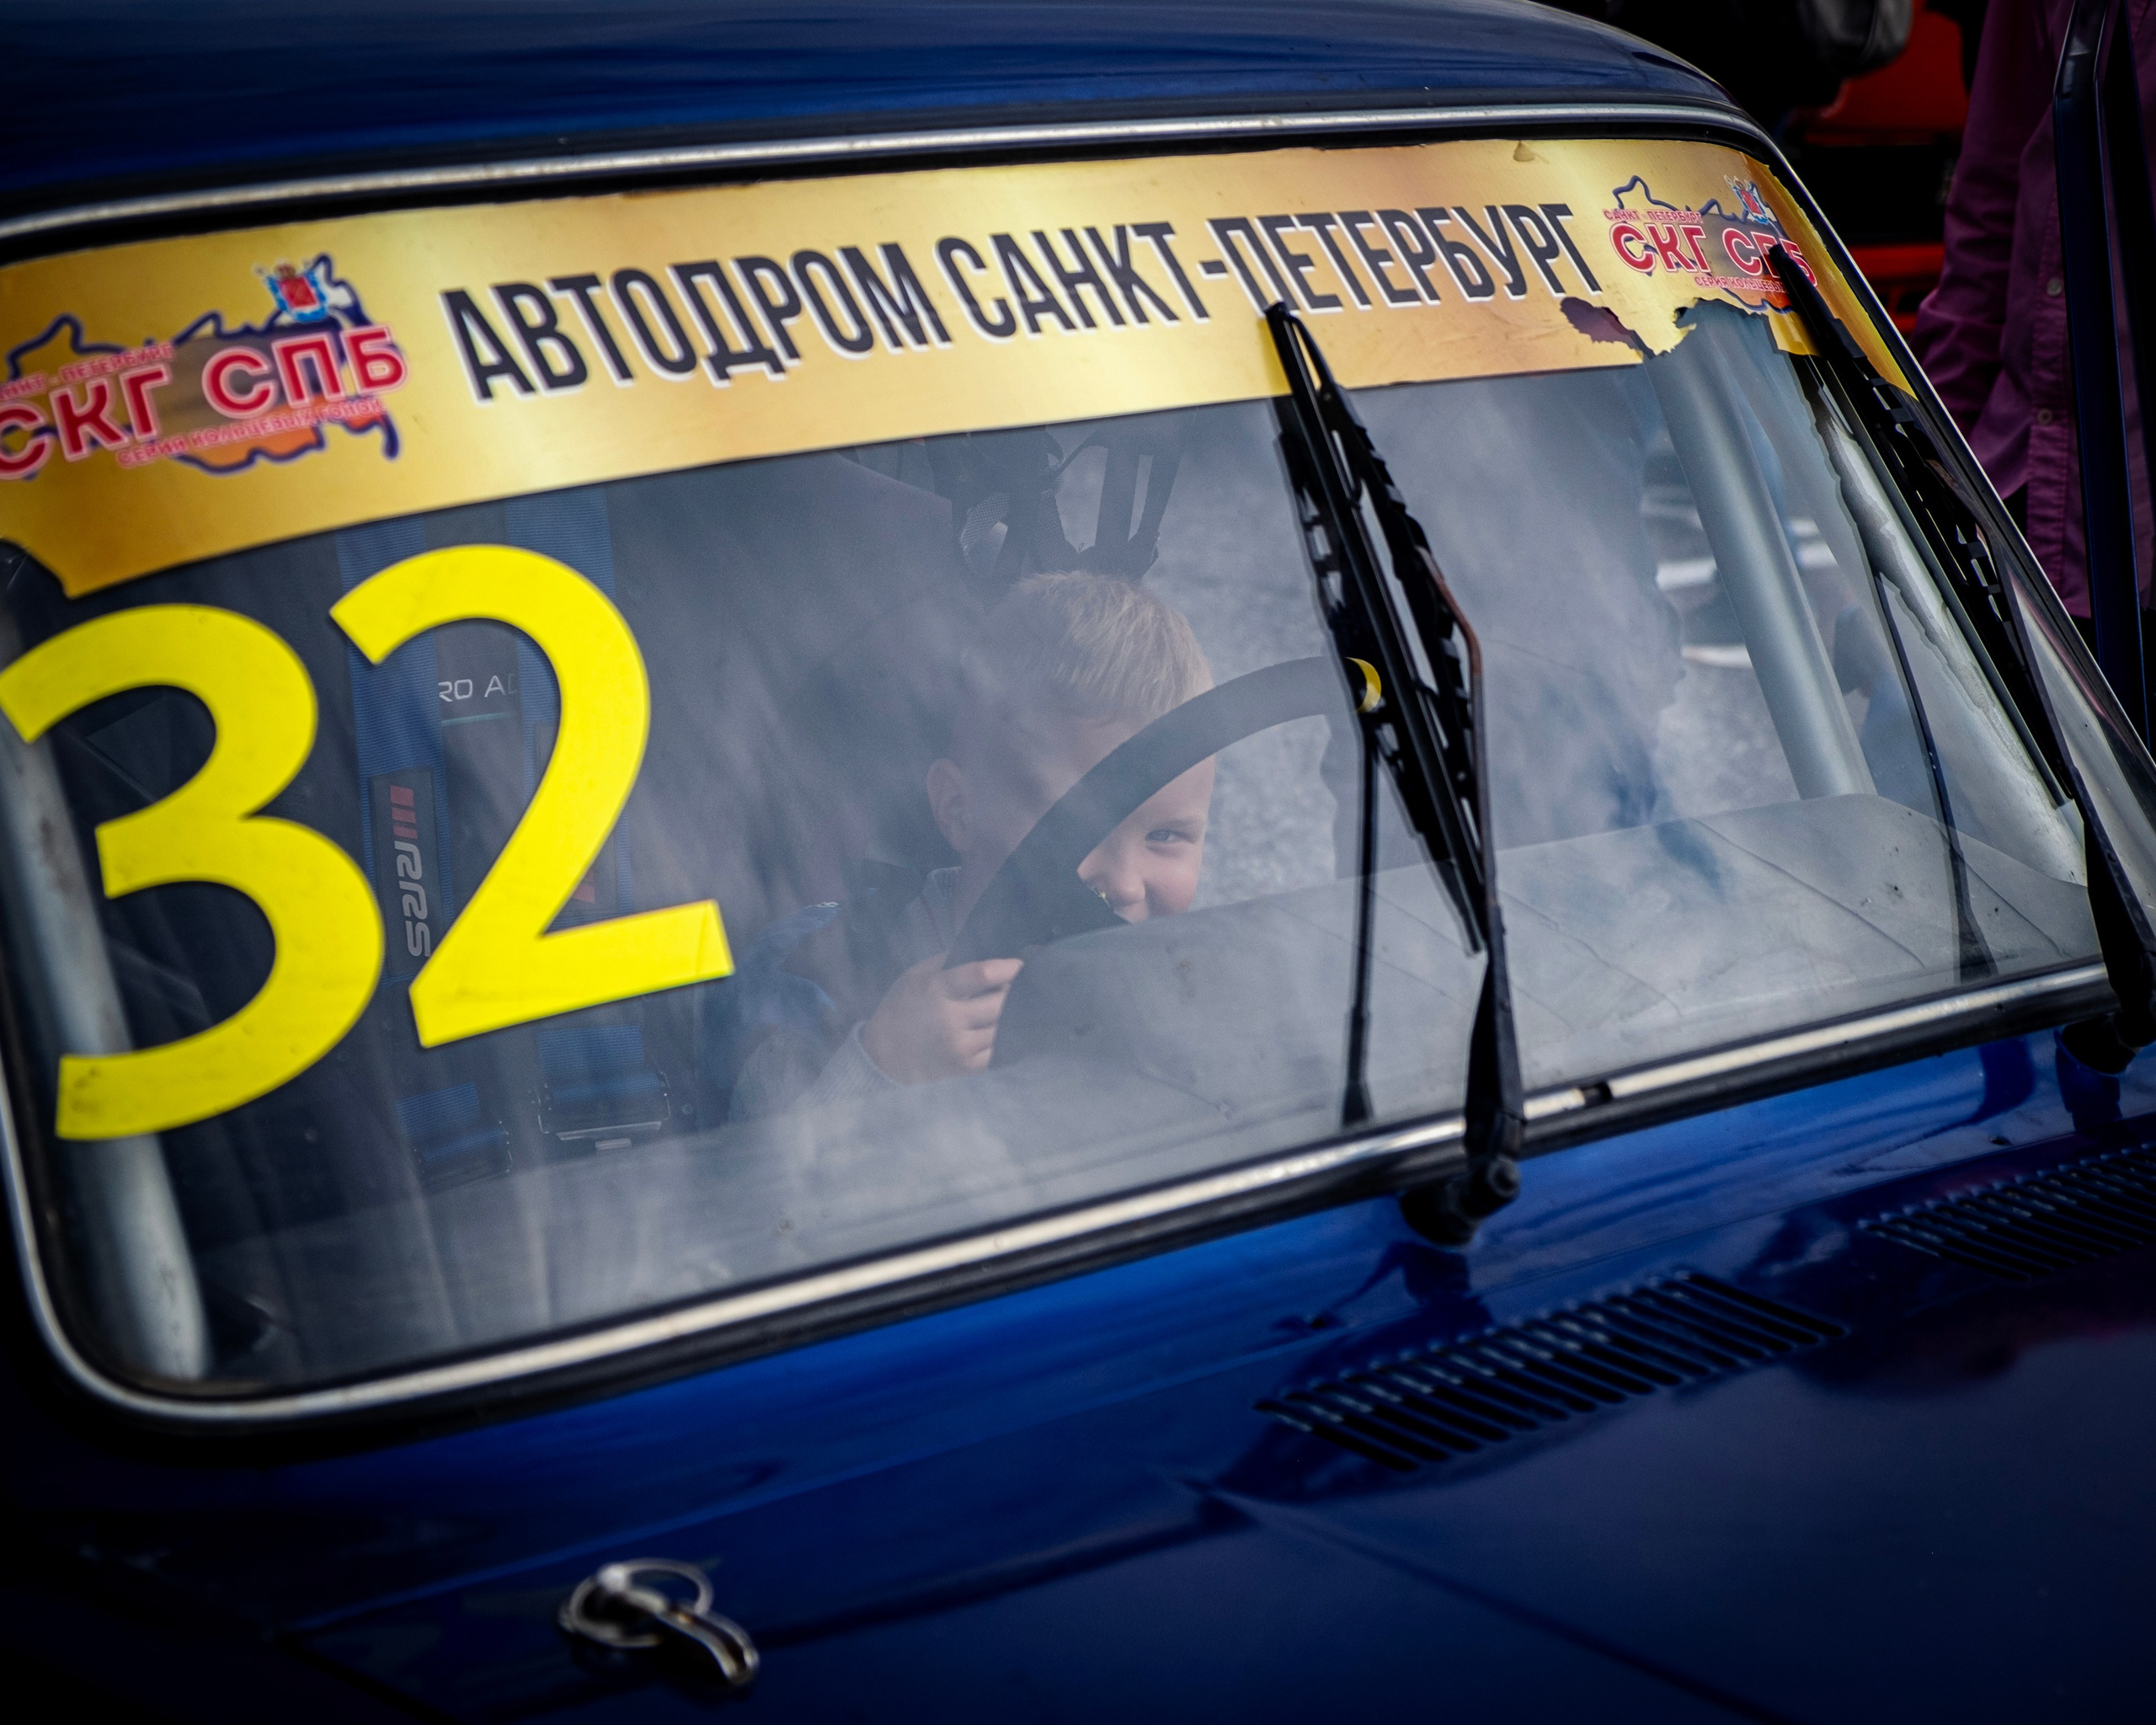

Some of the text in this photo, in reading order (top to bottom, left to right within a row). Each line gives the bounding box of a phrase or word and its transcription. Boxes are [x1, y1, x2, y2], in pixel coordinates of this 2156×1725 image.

[1603, 208, 1641, 222] САНКТ
[1646, 209, 1703, 224] ПЕТЕРБУРГ
[1609, 222, 1712, 274] СКГ
[438, 203, 1604, 406] АВТОДРОМ САНКТ-ПЕТЕРБУРГ
[1694, 275, 1785, 294] СЕРИЯ КОЛЬЦЕВЫ
[0, 323, 408, 479] СКГ СПБ
[0, 543, 735, 1140] 32
